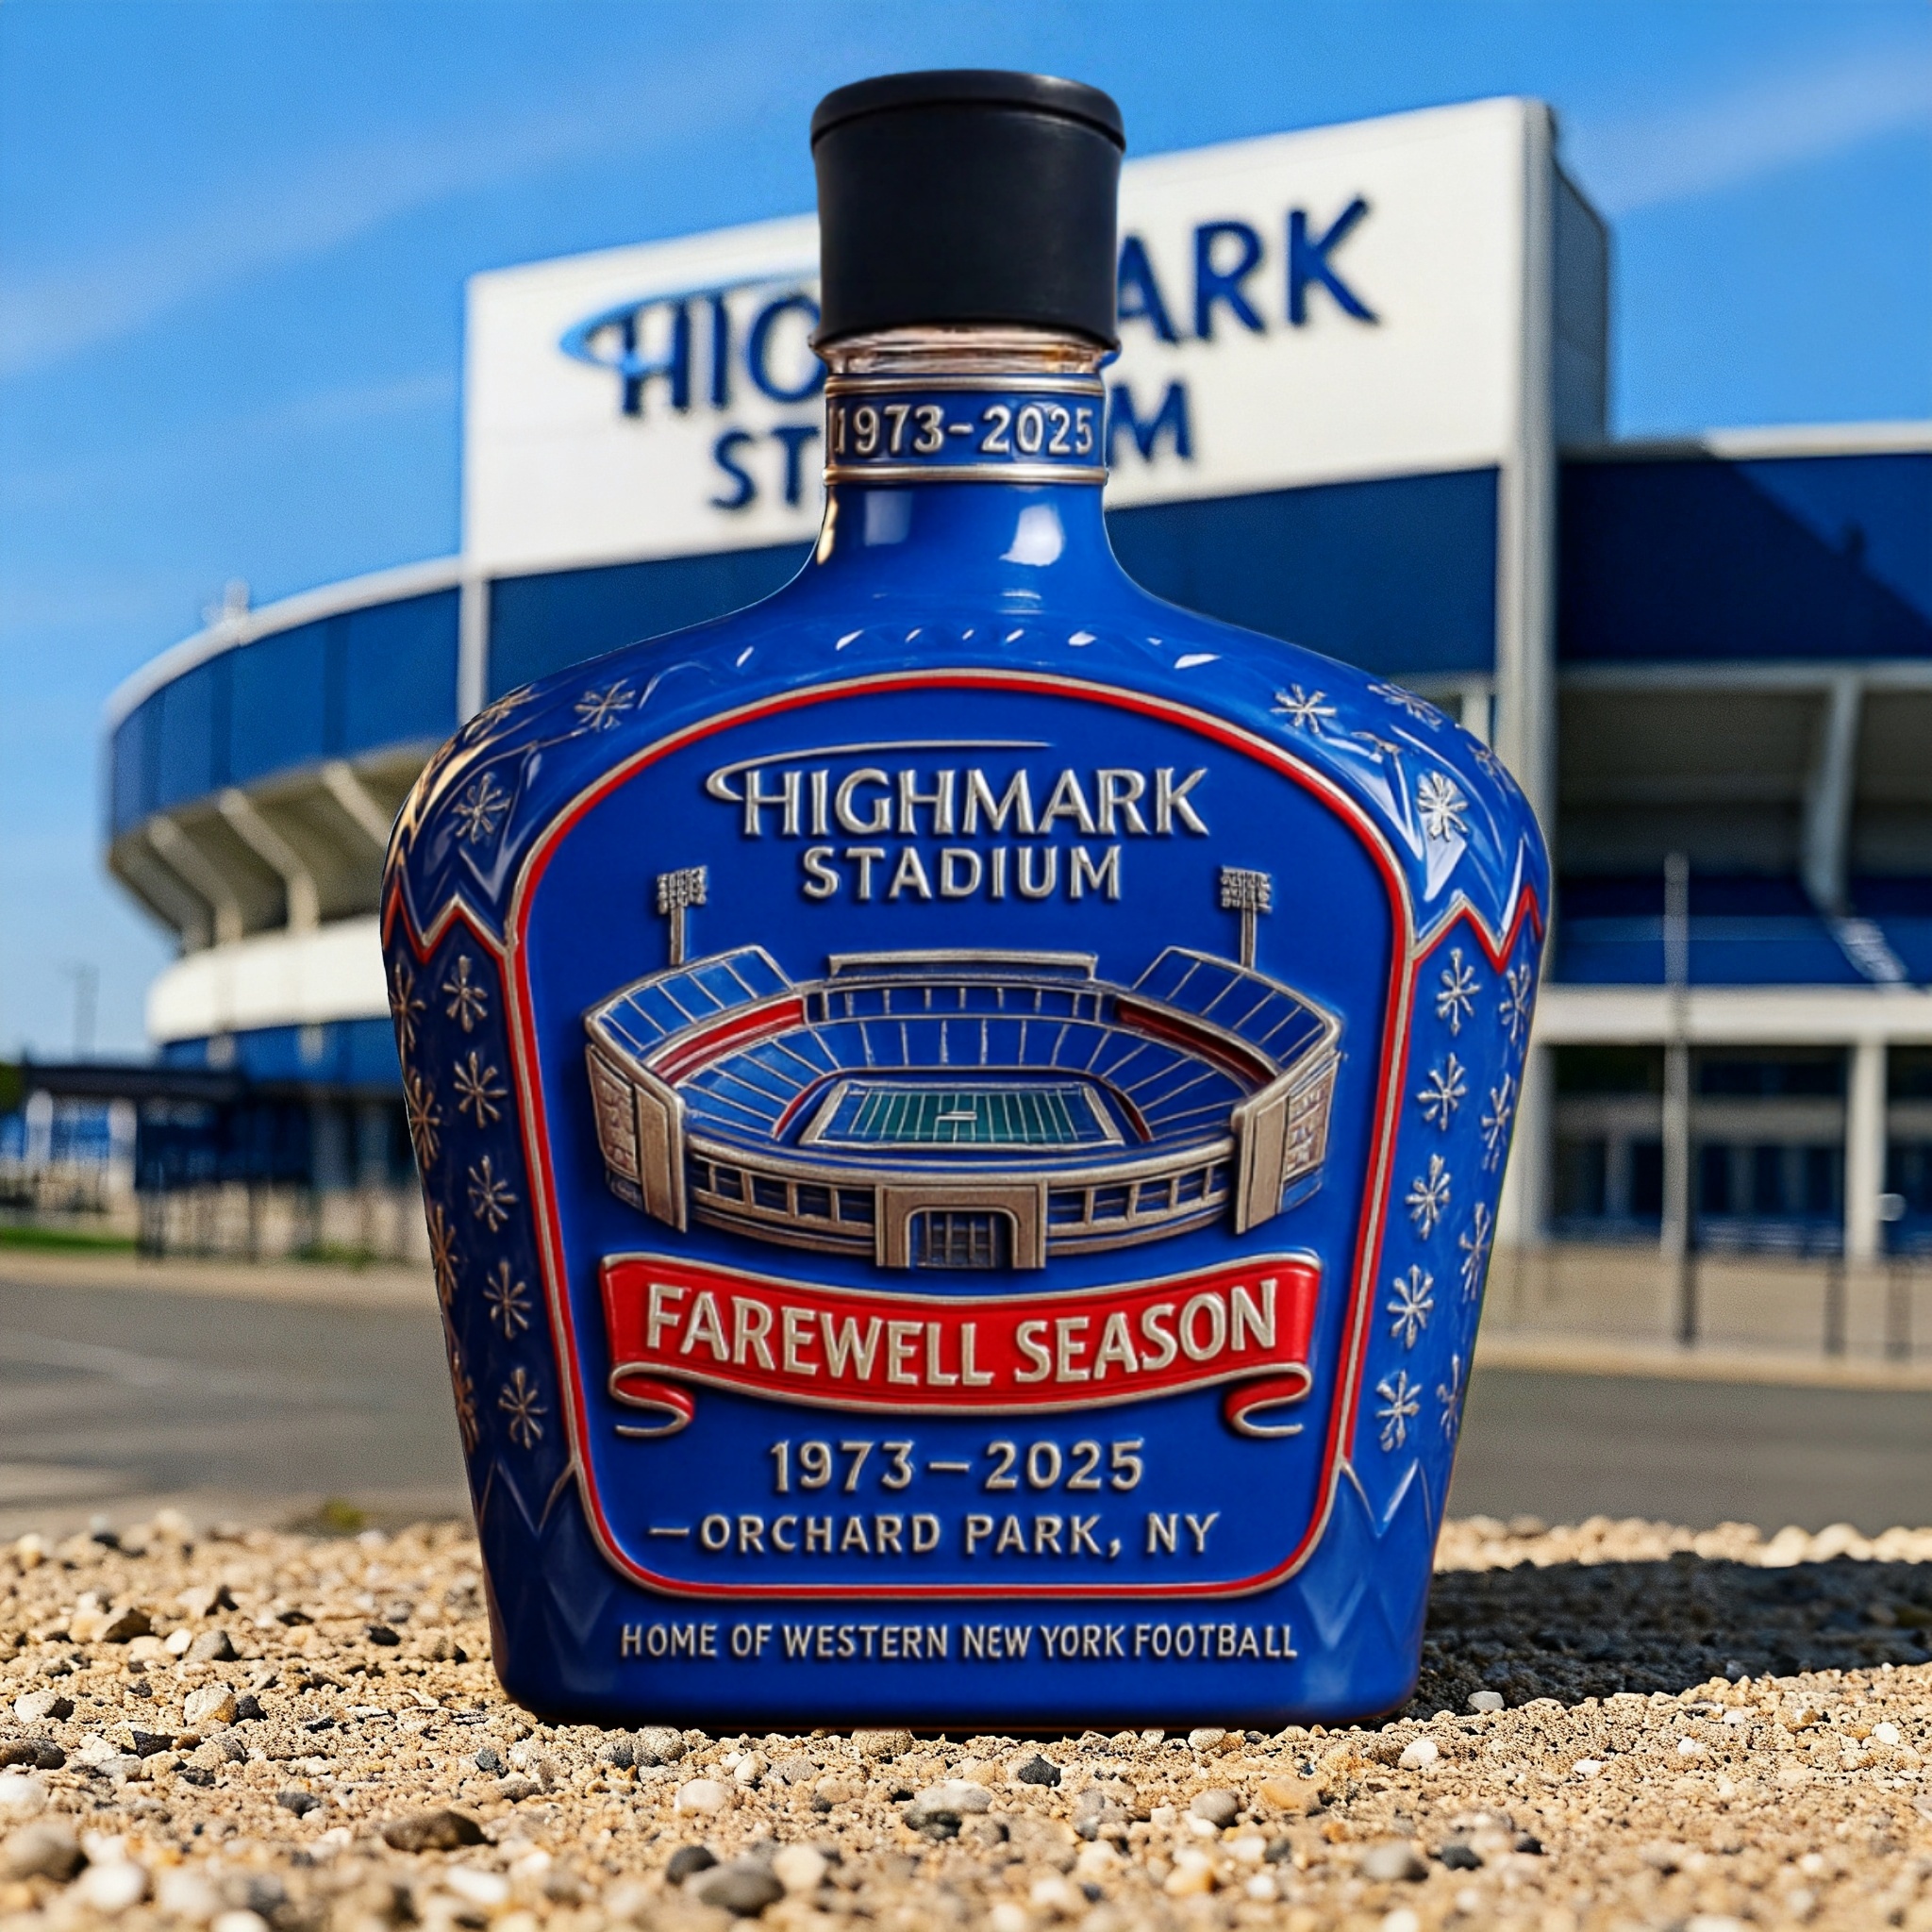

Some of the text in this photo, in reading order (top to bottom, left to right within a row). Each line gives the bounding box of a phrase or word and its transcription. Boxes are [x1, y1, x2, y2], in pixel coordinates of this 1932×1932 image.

[606, 196, 1380, 415] HIGARK
[833, 403, 1094, 456] 1973-2025
[741, 766, 1211, 837] HIGHMARK
[802, 844, 1122, 900] STADIUM
[646, 1277, 1278, 1386] FAREWELL SEASON
[964, 1513, 1123, 1557] PARK,
[1146, 1511, 1221, 1554] NY
[620, 1623, 1299, 1658] HOME OF WESTERN NEW YORK FOOTBALL
